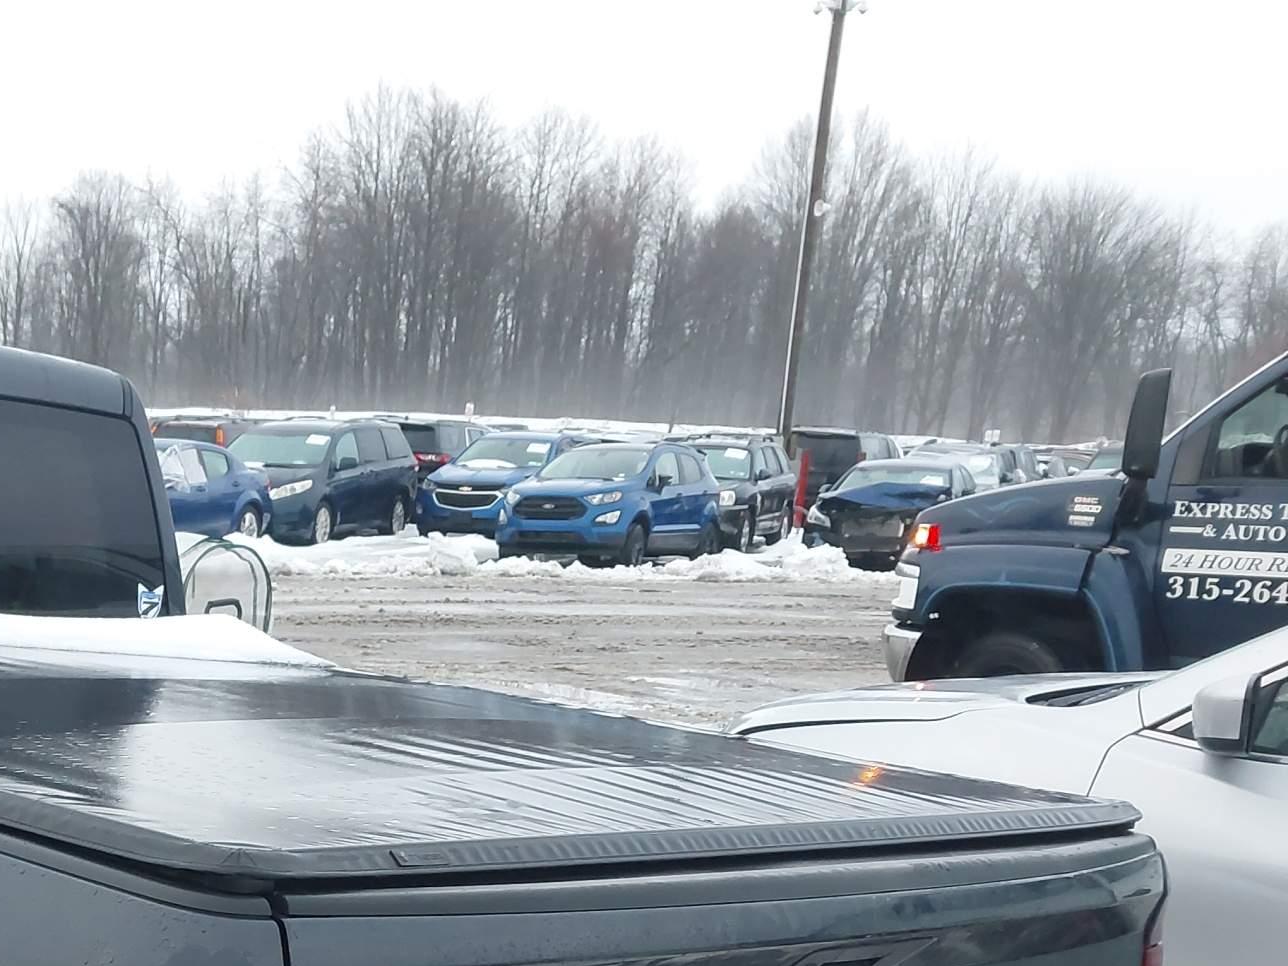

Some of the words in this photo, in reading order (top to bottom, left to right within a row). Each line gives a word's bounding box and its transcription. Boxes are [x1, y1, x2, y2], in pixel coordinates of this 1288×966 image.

[1172, 500, 1273, 520] EXPRESS
[1202, 524, 1217, 537] &
[1221, 523, 1287, 542] AUTO
[1169, 553, 1194, 568] 24
[1198, 554, 1263, 571] HOUR
[1165, 575, 1288, 604] 315-264
